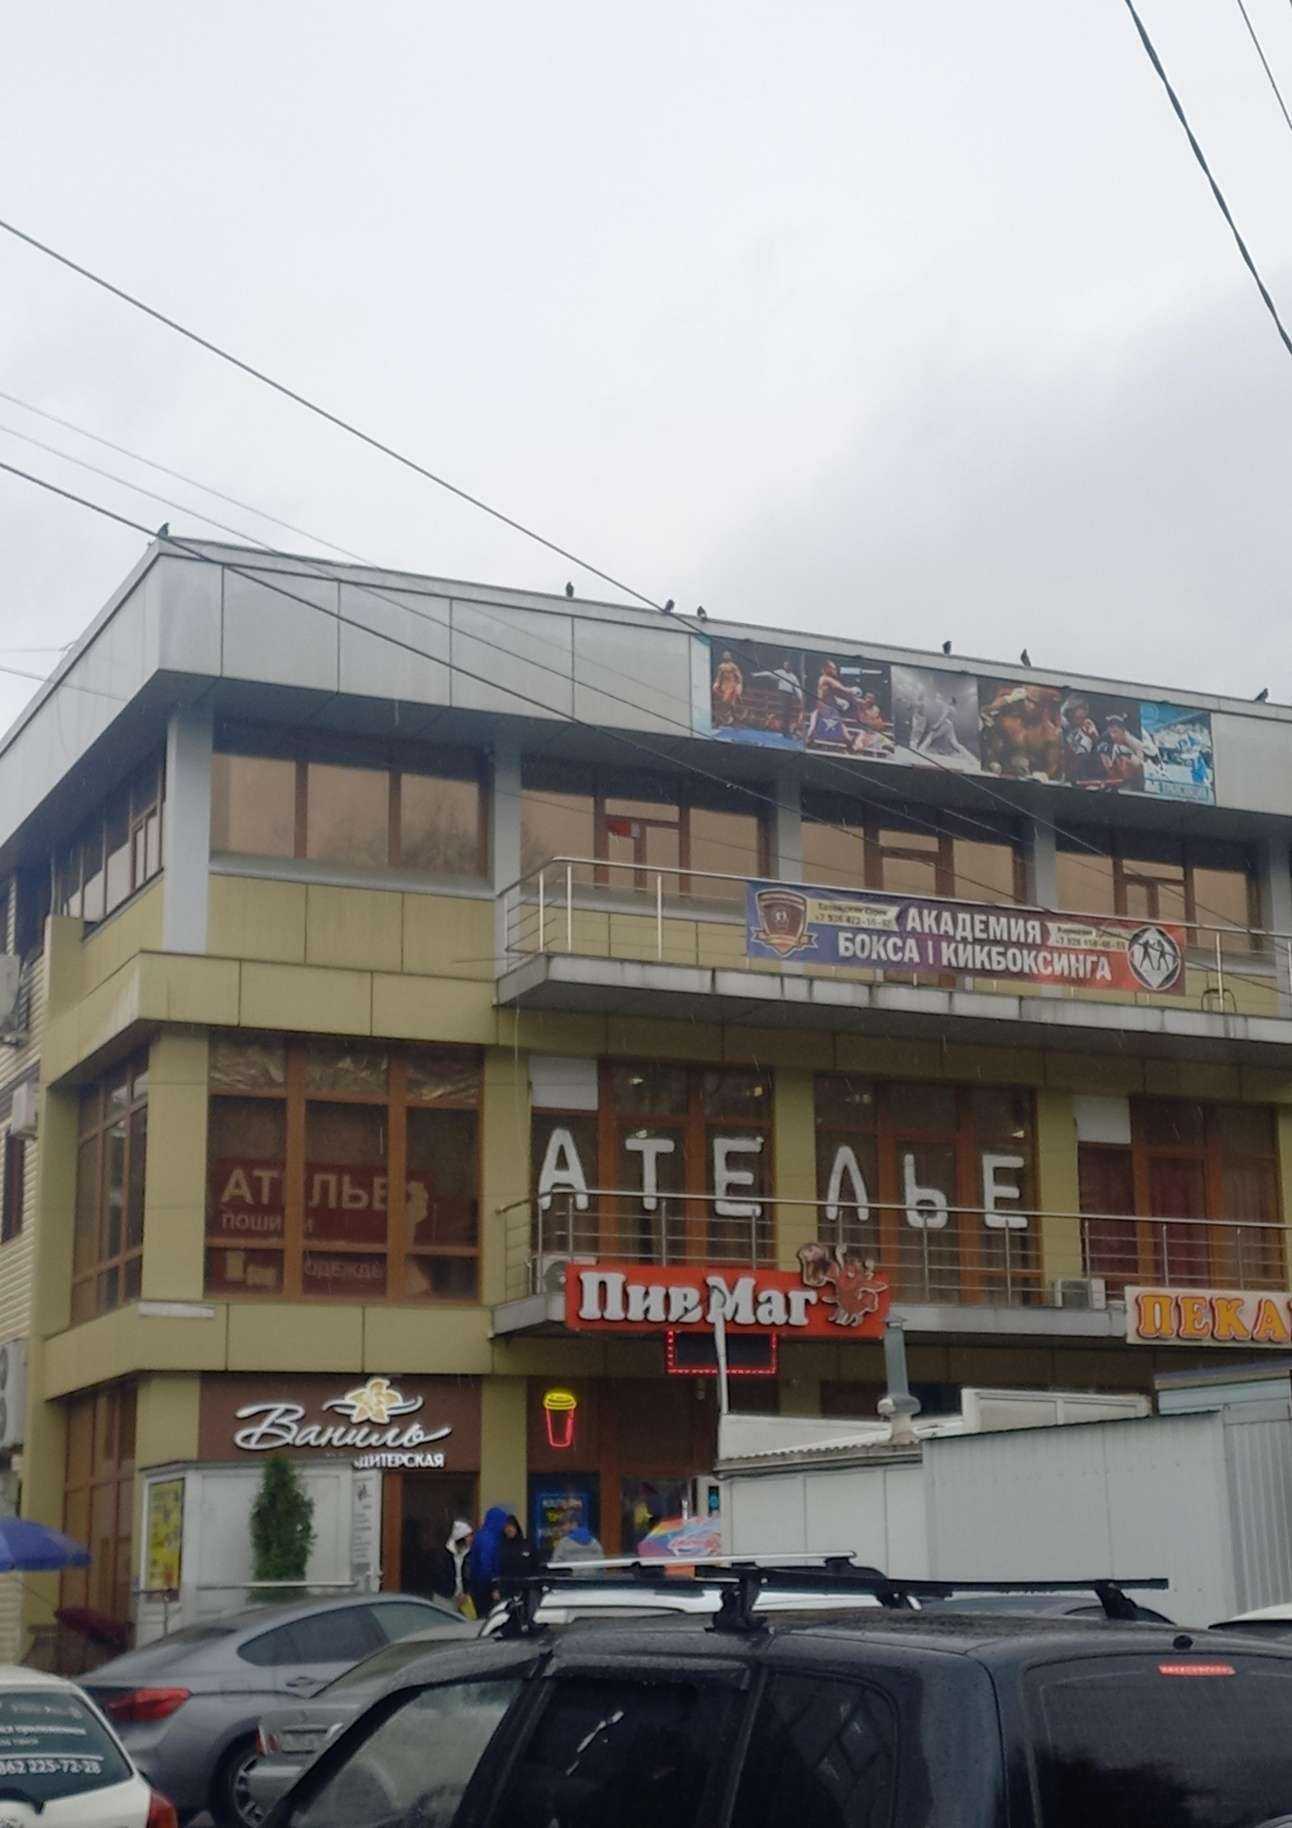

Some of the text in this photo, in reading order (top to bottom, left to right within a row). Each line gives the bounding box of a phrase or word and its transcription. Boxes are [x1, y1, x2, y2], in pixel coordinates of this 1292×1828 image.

[906, 907, 1042, 944] АКАДЕМИЯ
[838, 931, 920, 963] БОКСА
[941, 941, 1112, 981] КИКБОКСИНГА
[221, 1168, 388, 1211] АТЛЬЕ
[538, 1127, 1029, 1230] АТЕЛЬЕ
[234, 1402, 453, 1451] Ваниль
[353, 1452, 446, 1469] ДИТЕРСКАЯ
